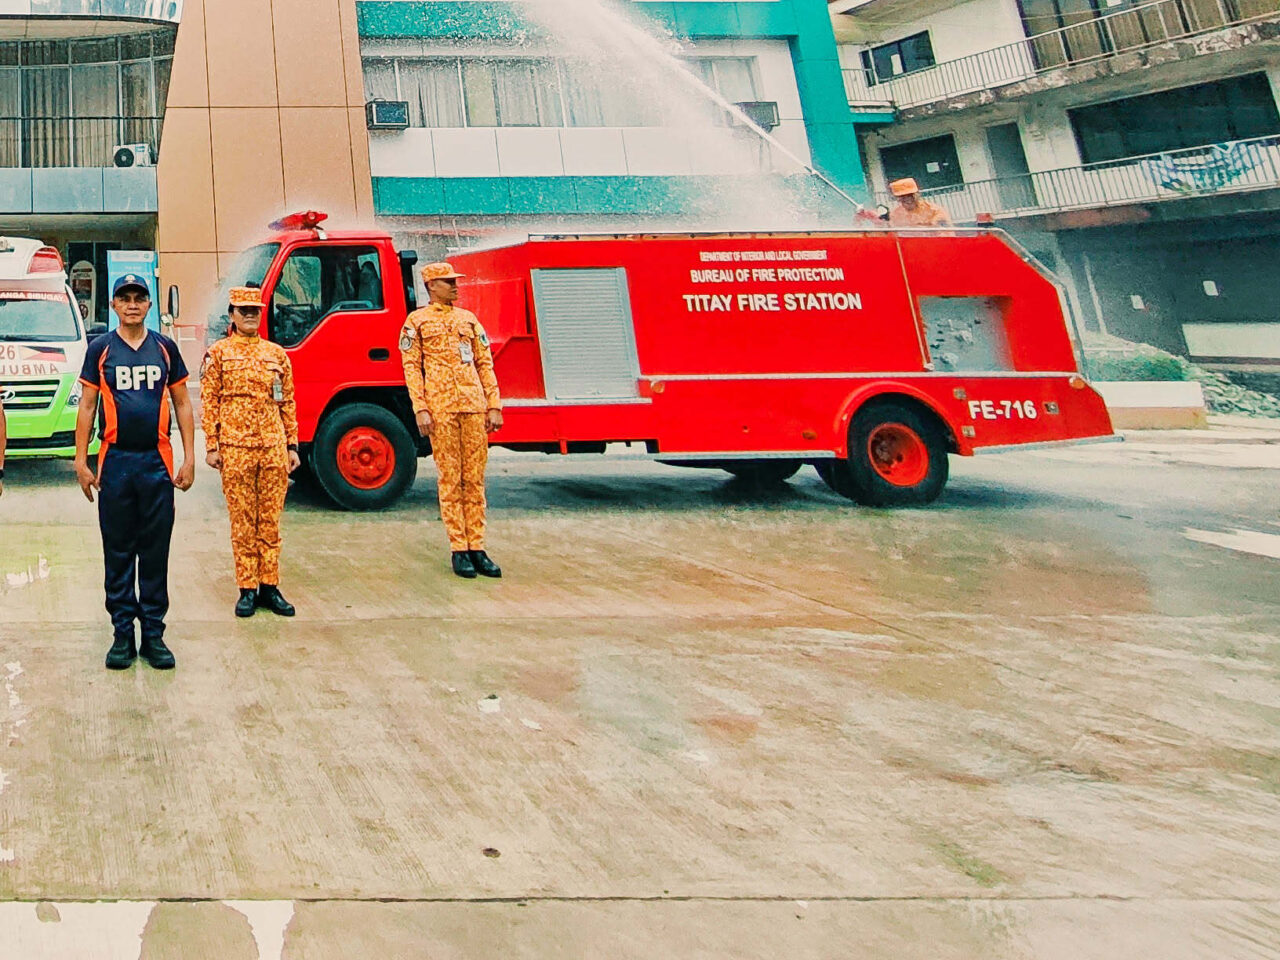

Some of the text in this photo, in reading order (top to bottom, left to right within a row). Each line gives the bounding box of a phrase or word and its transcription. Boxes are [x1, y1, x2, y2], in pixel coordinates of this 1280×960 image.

[690, 268, 845, 283] BUREAU OF FIRE PROTECTION
[682, 293, 862, 312] TITAY FIRE STATION
[115, 365, 162, 391] BFP
[967, 400, 1037, 419] FE-716
